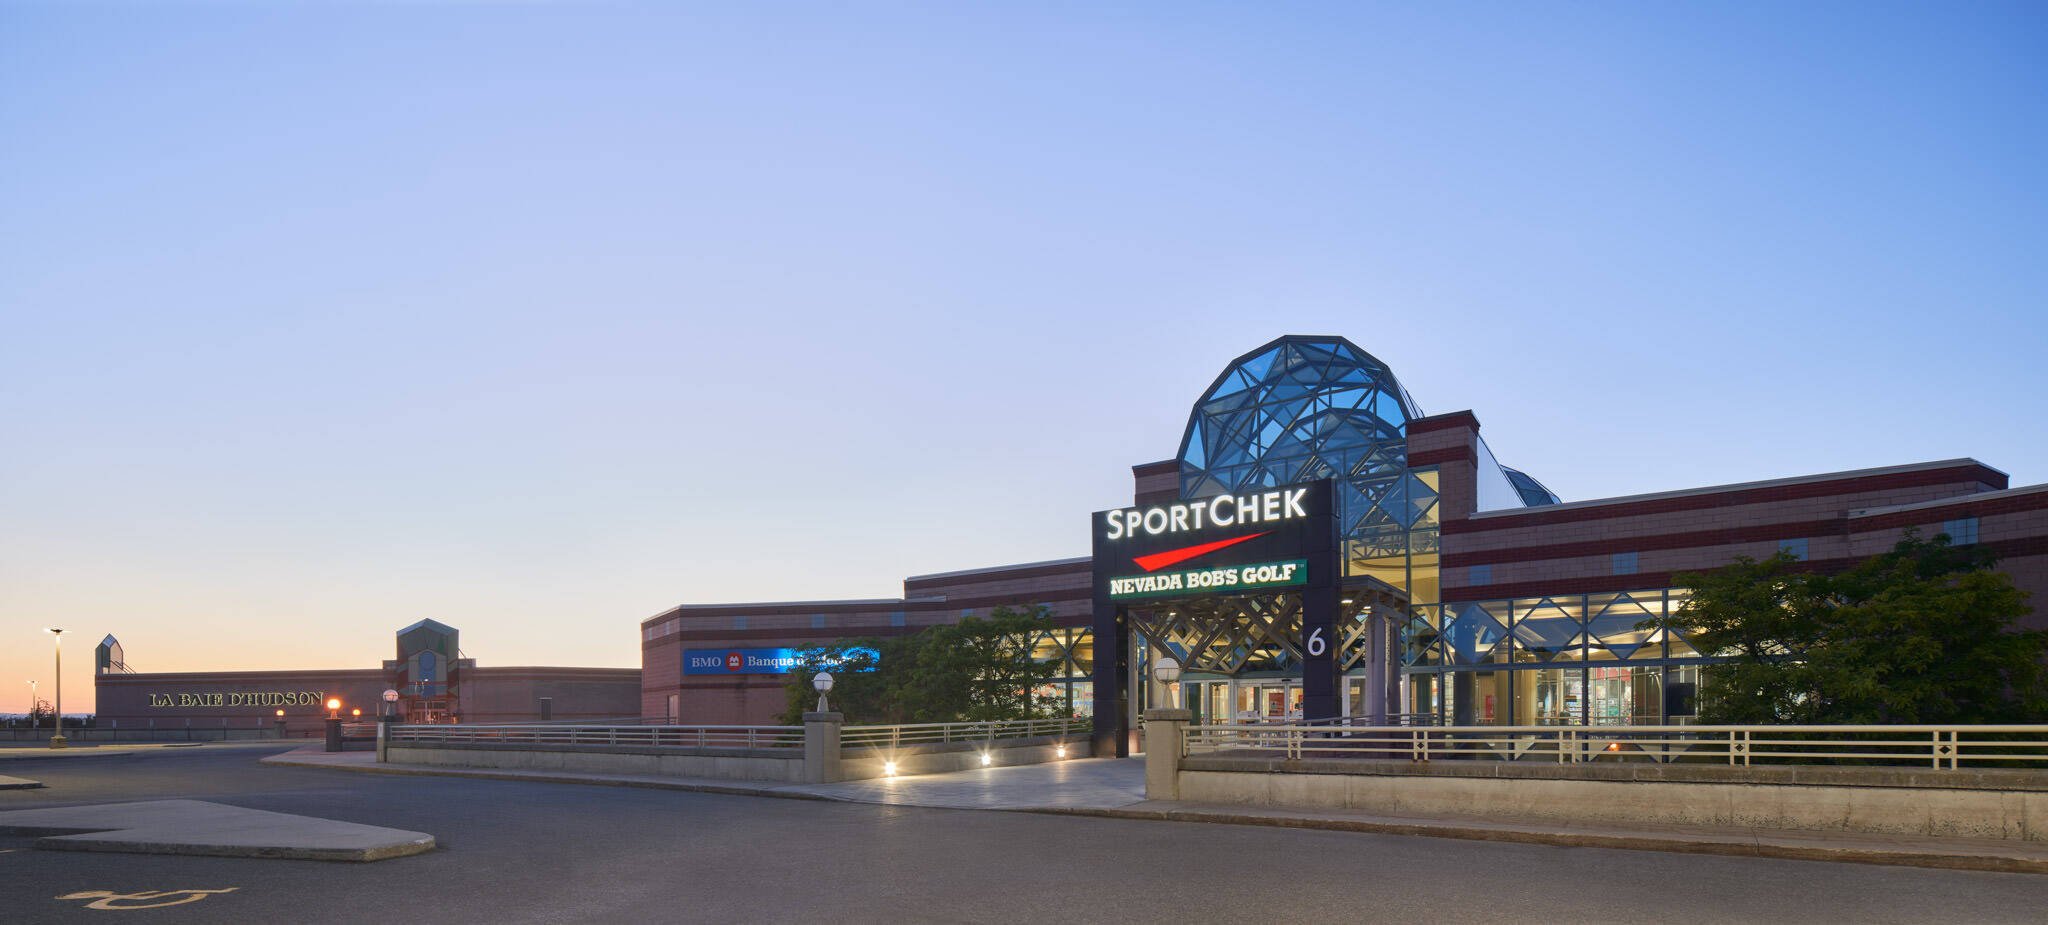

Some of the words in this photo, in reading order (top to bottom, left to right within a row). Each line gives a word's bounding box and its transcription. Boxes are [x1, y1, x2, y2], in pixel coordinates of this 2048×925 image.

[1110, 575, 1183, 595] NEVADA
[1187, 569, 1238, 589] BOB'S
[1242, 564, 1296, 583] GOLF
[1308, 627, 1326, 656] 6
[692, 657, 721, 668] BMO
[748, 656, 794, 669] Banque
[149, 694, 175, 707] LA
[178, 694, 224, 707] BAIE
[228, 692, 324, 707] D'HUDSON
